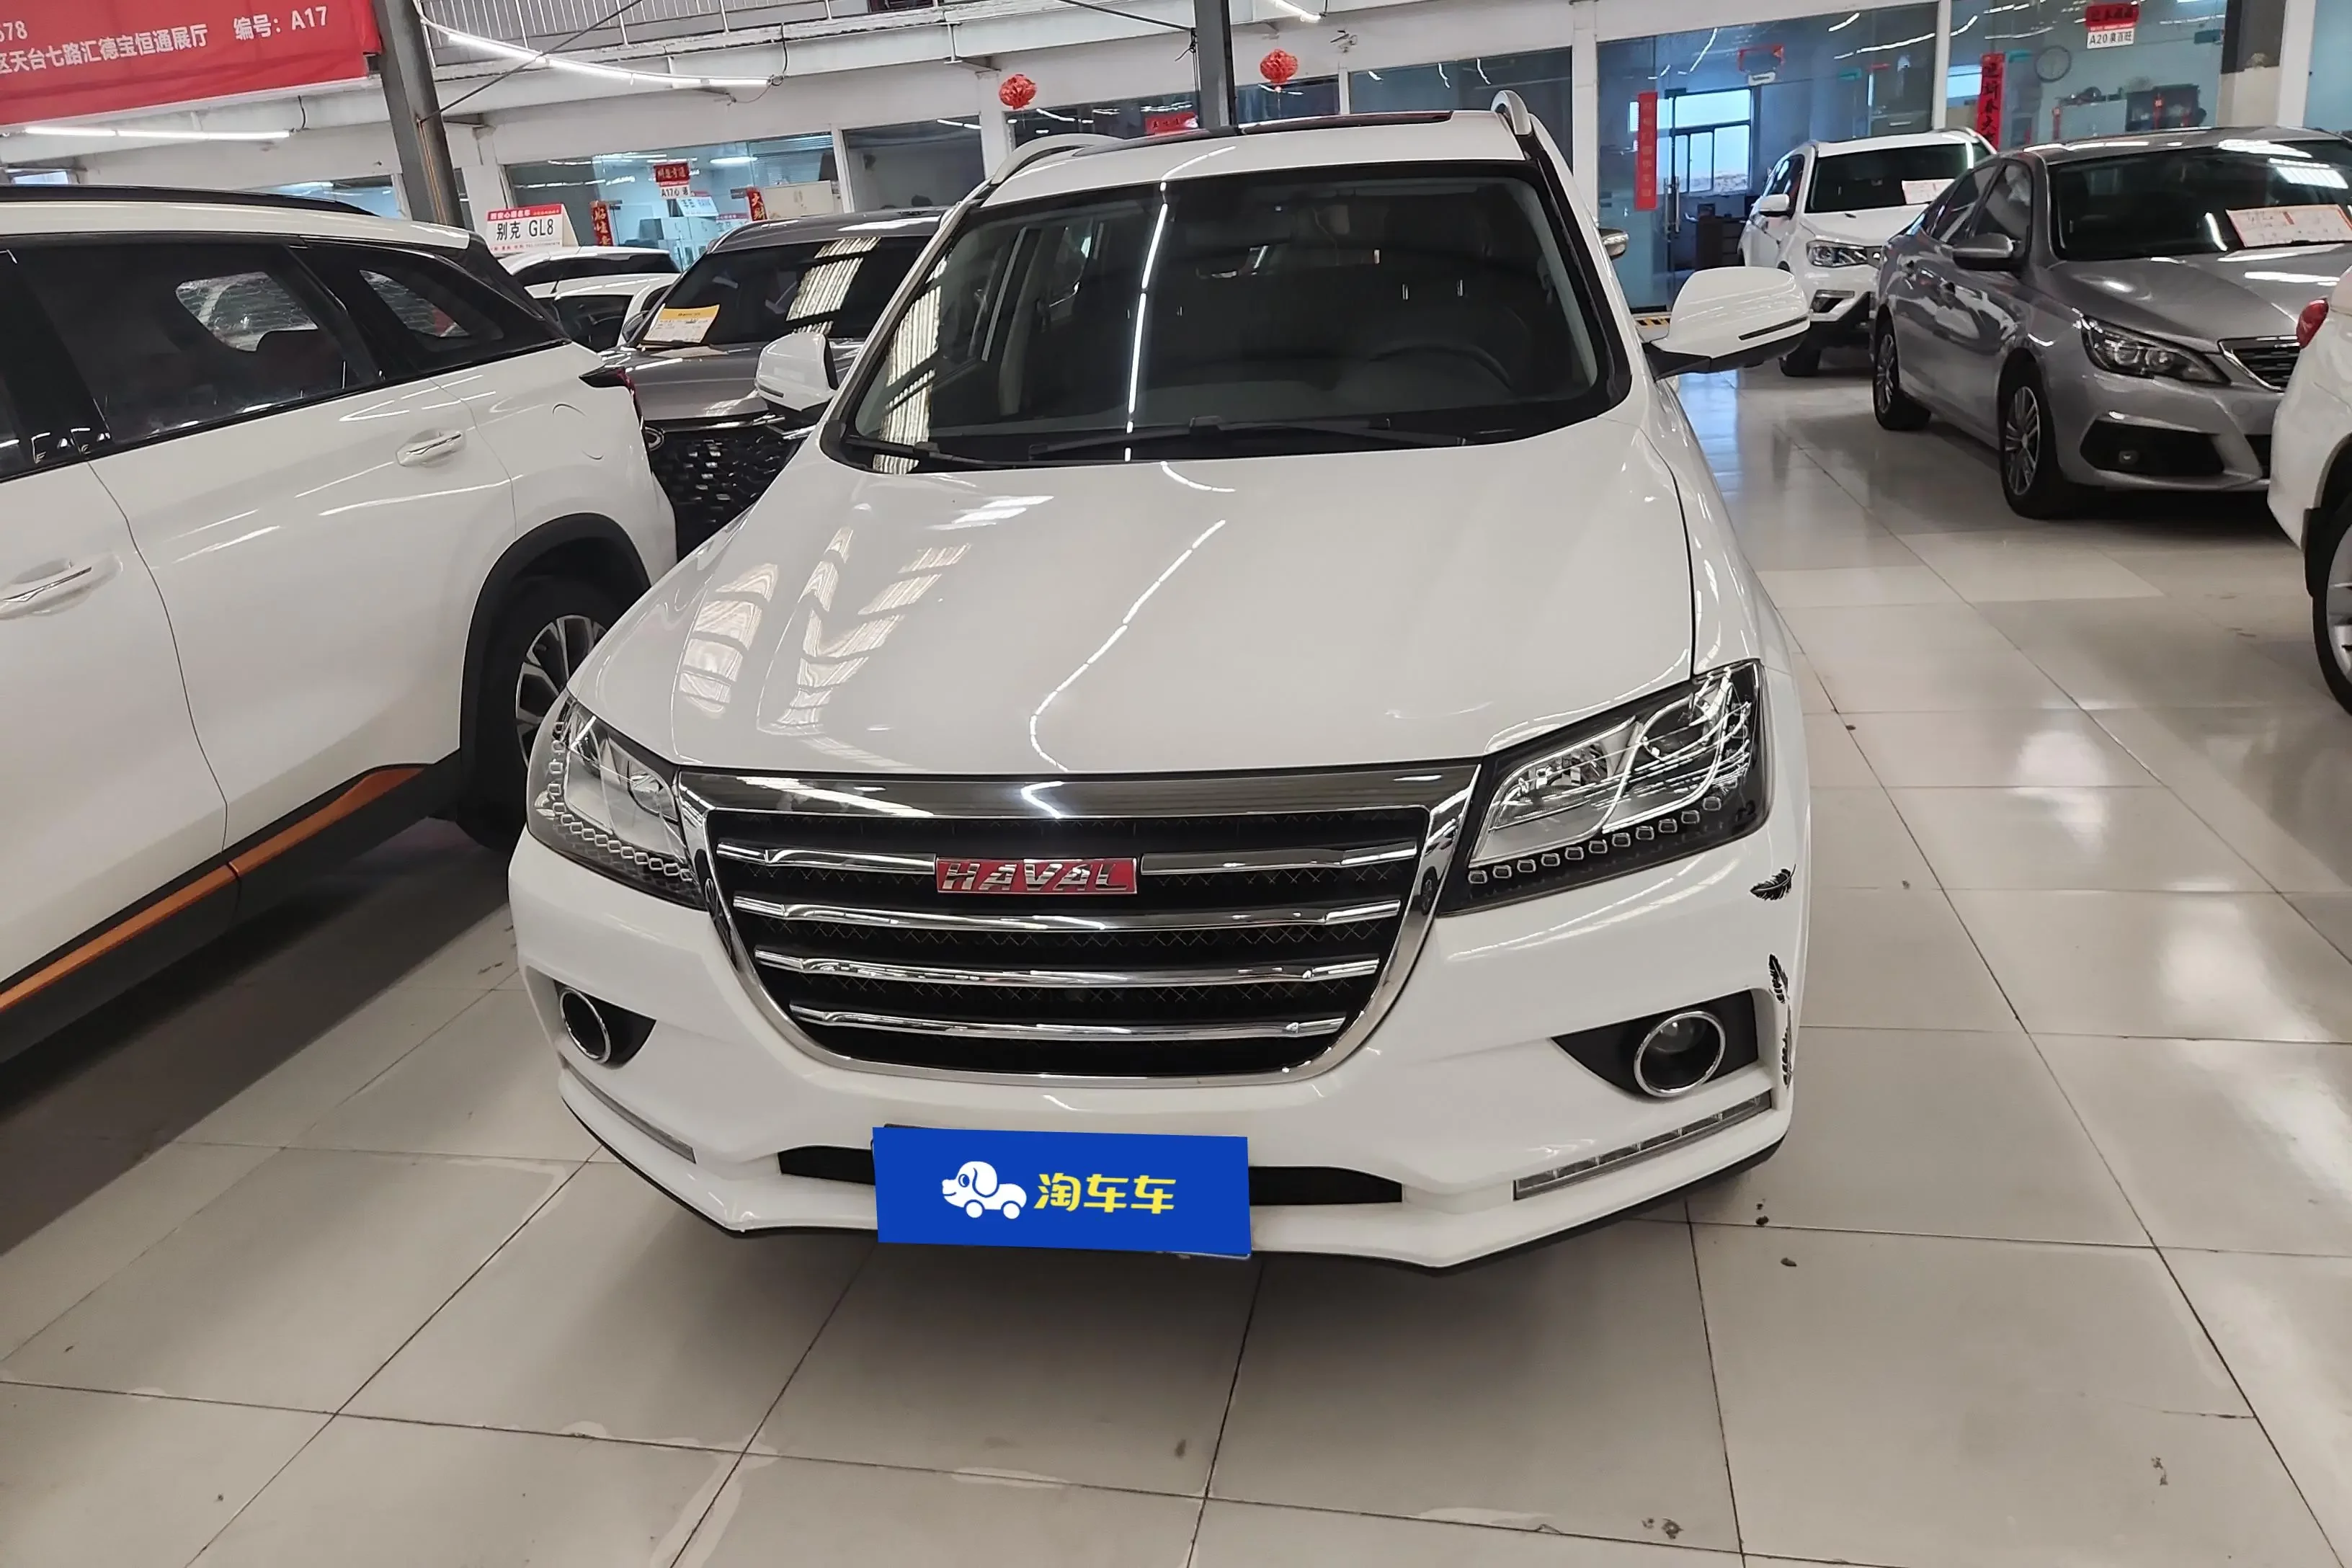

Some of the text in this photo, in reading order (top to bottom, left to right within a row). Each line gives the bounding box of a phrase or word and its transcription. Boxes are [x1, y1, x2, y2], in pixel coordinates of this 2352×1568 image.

[0, 20, 28, 43] 78
[2090, 34, 2108, 44] A20
[496, 218, 553, 241] 别克 GL8
[942, 863, 1128, 891] HAVAL
